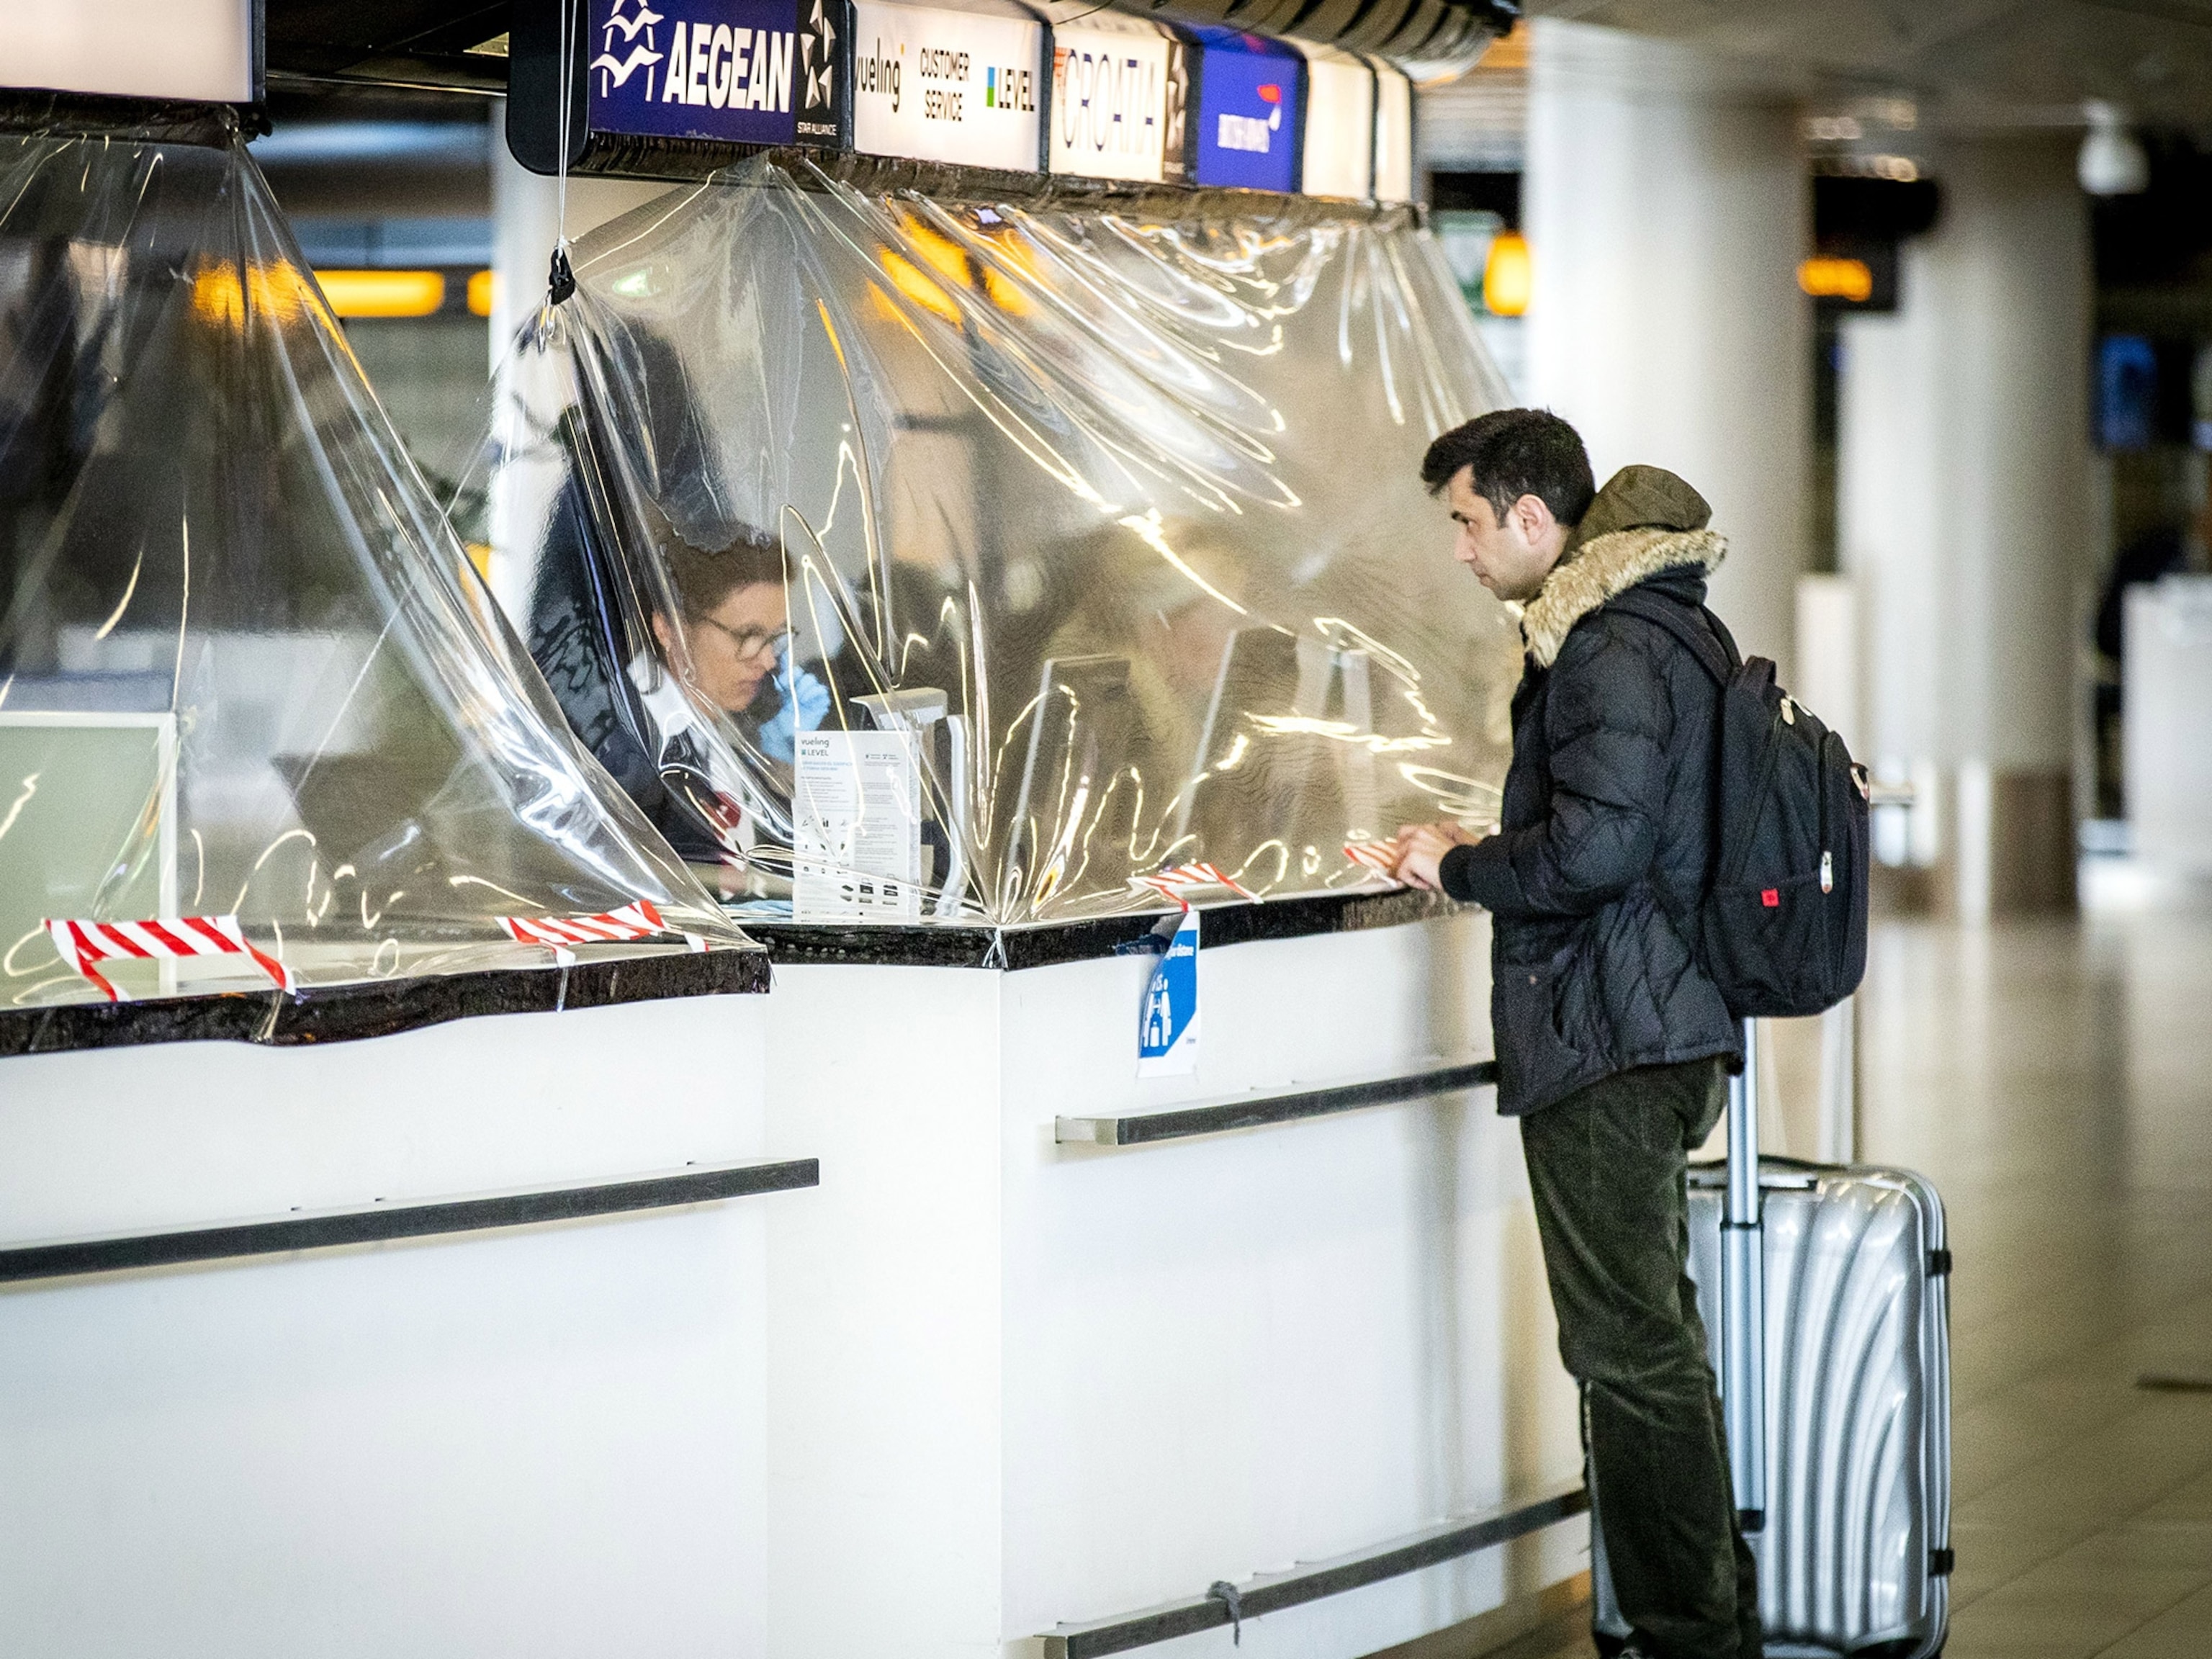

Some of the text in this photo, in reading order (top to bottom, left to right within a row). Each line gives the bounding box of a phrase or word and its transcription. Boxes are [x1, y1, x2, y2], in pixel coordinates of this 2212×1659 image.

[662, 21, 794, 113] AEGEAN
[920, 48, 970, 81] CUSTOMER
[925, 89, 962, 122] SERVICE
[999, 68, 1034, 112] LEVEL
[798, 121, 837, 136] STAR ALLIANCE
[801, 737, 830, 748] vueling
